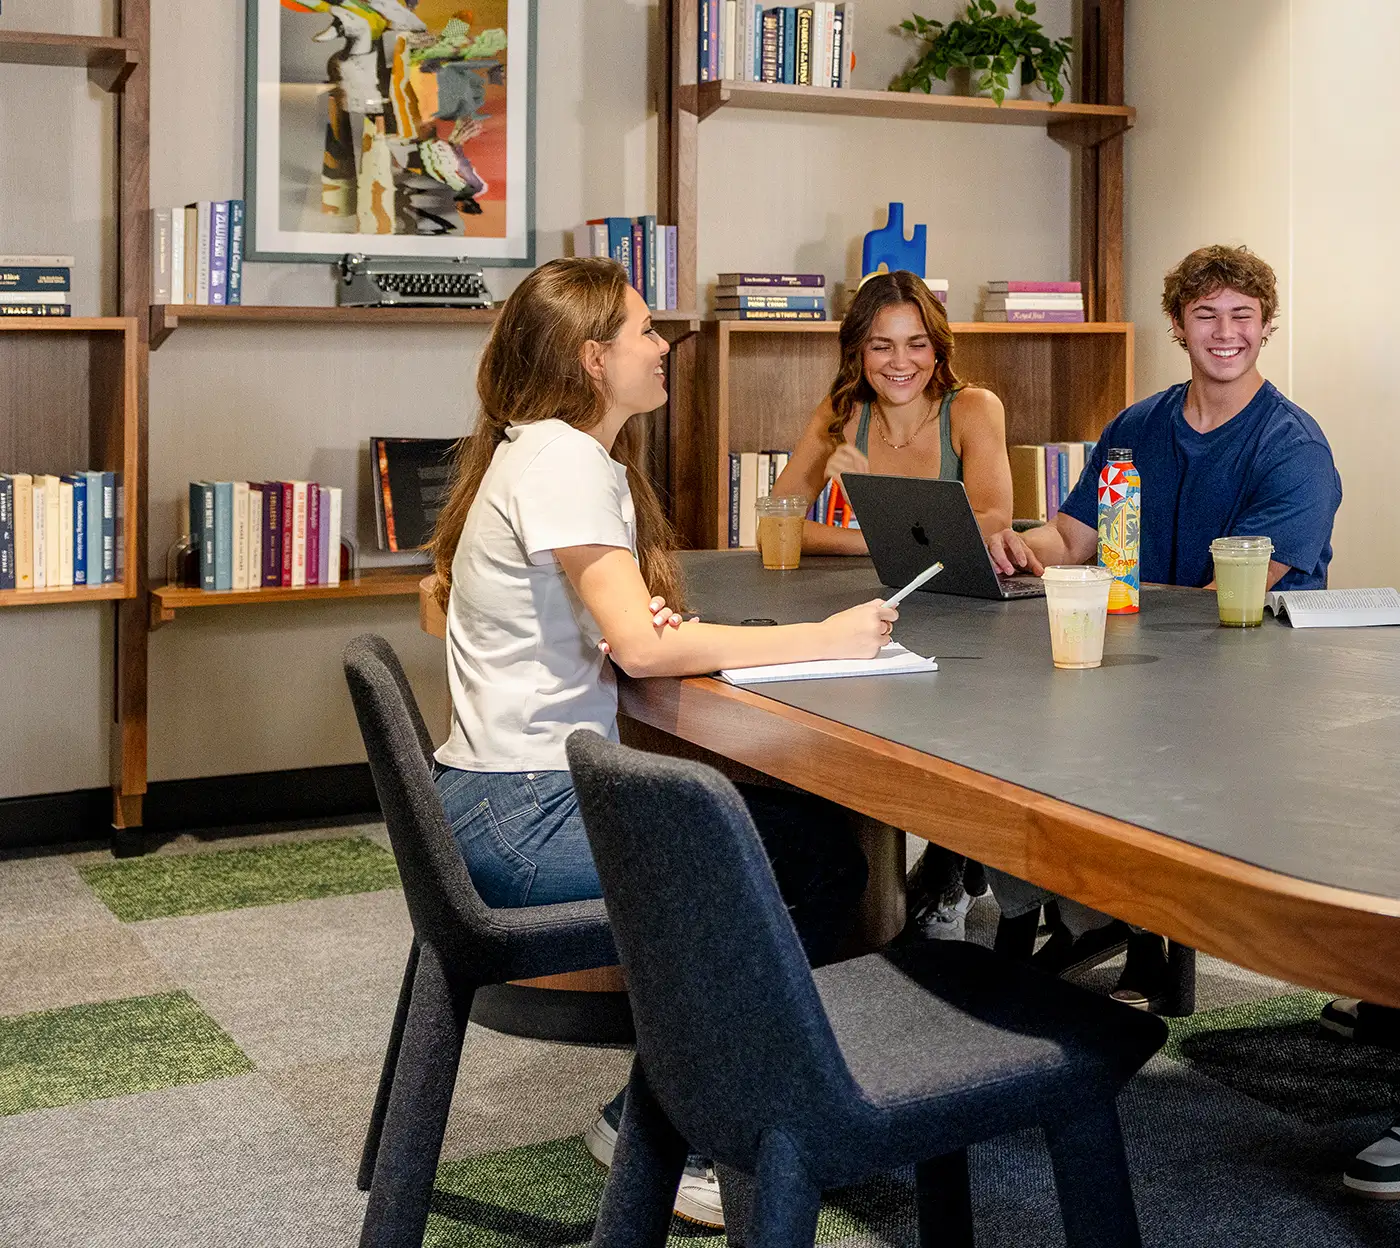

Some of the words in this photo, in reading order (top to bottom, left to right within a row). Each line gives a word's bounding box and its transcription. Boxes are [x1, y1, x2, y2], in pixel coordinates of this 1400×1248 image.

[215, 214, 226, 236] ZULU
[233, 225, 242, 241] Wild
[214, 236, 225, 258] HEART
[232, 241, 241, 254] and
[621, 236, 630, 267] LOCKED
[230, 254, 241, 272] Crazy
[230, 272, 241, 289] Guys
